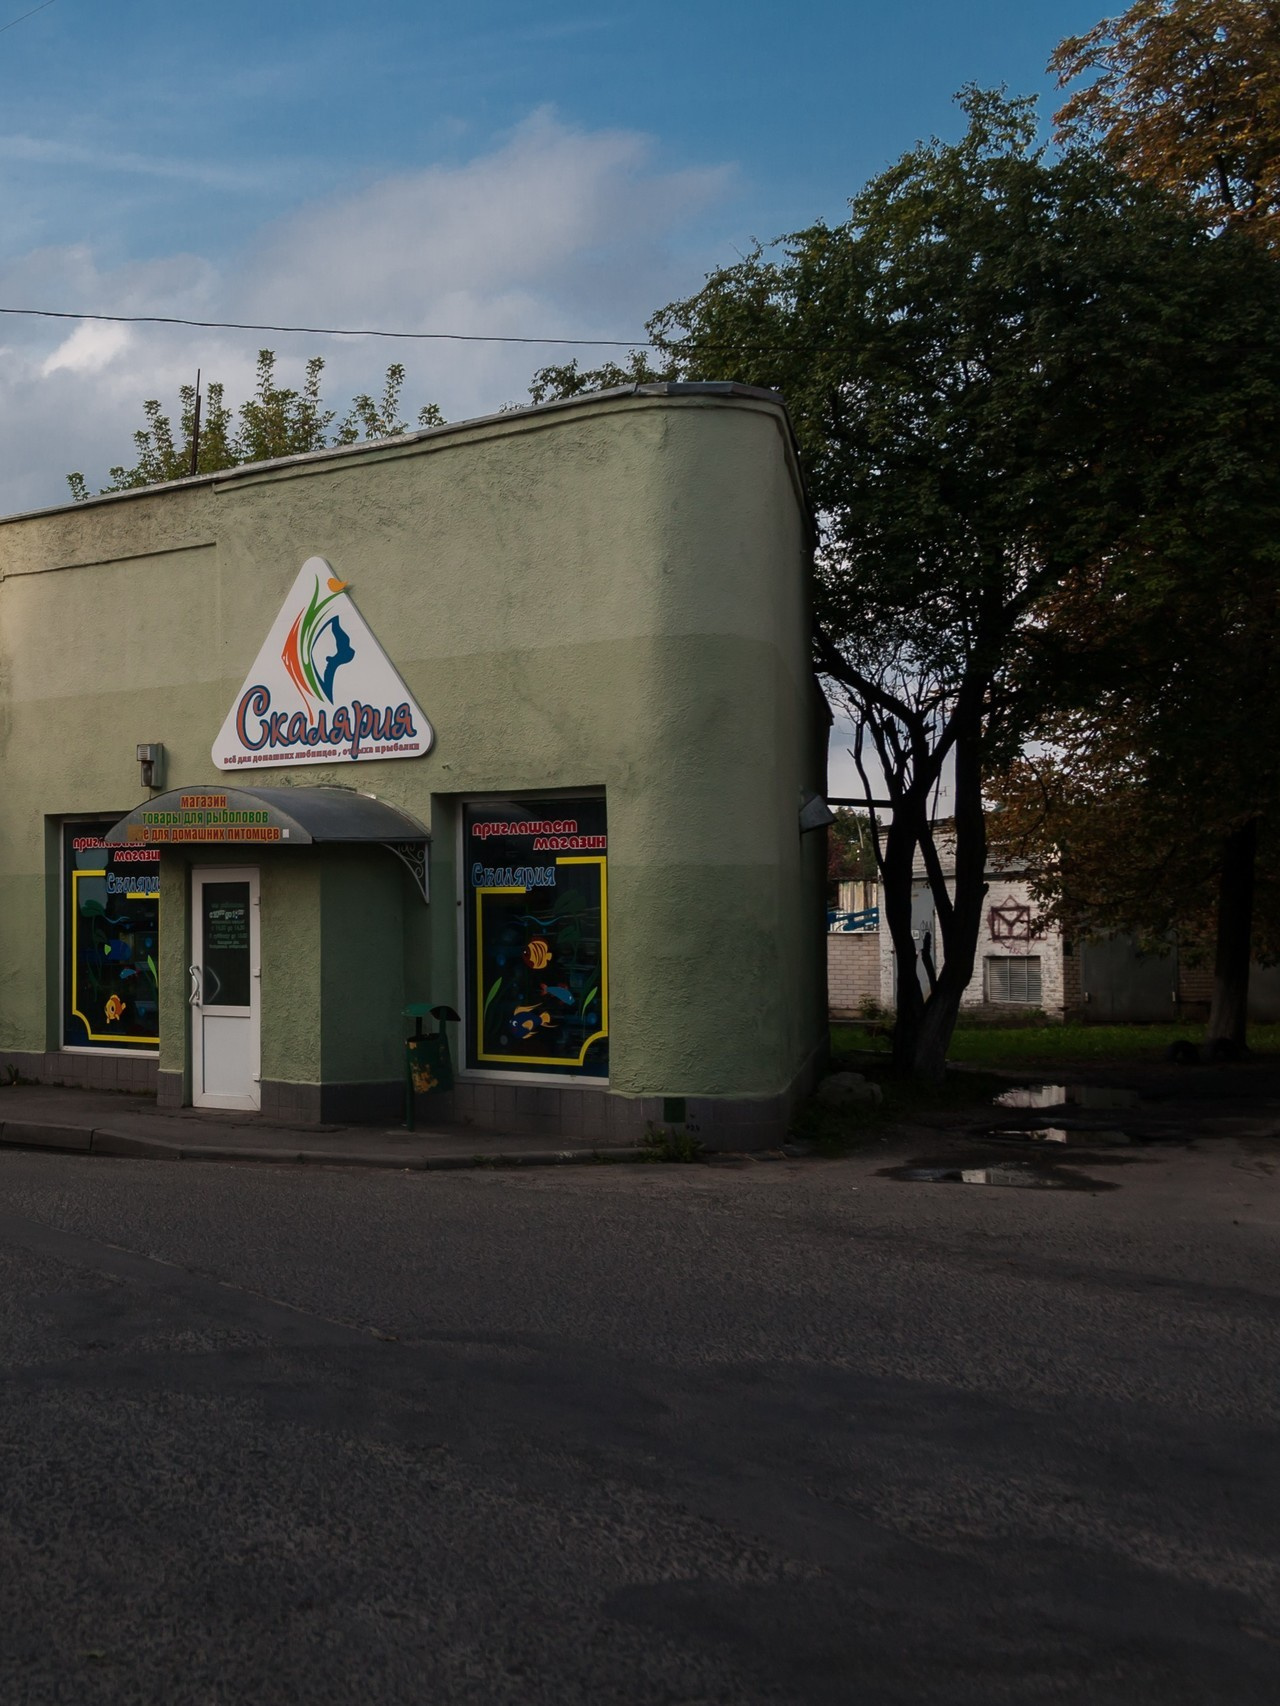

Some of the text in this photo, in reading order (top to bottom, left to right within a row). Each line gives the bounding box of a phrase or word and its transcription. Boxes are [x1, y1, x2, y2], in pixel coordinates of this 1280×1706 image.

[236, 685, 417, 759] Скалярия
[237, 756, 252, 765] для
[253, 752, 294, 763] домашних
[180, 795, 228, 808] магазин
[142, 809, 269, 826] товары для рыболовов
[151, 828, 170, 842] для
[171, 828, 225, 842] домашних
[227, 827, 280, 841] питомцев
[472, 820, 578, 840] приглашает
[532, 835, 607, 850] магазин
[106, 872, 160, 895] Скаляри
[472, 862, 557, 891] Скалярия
